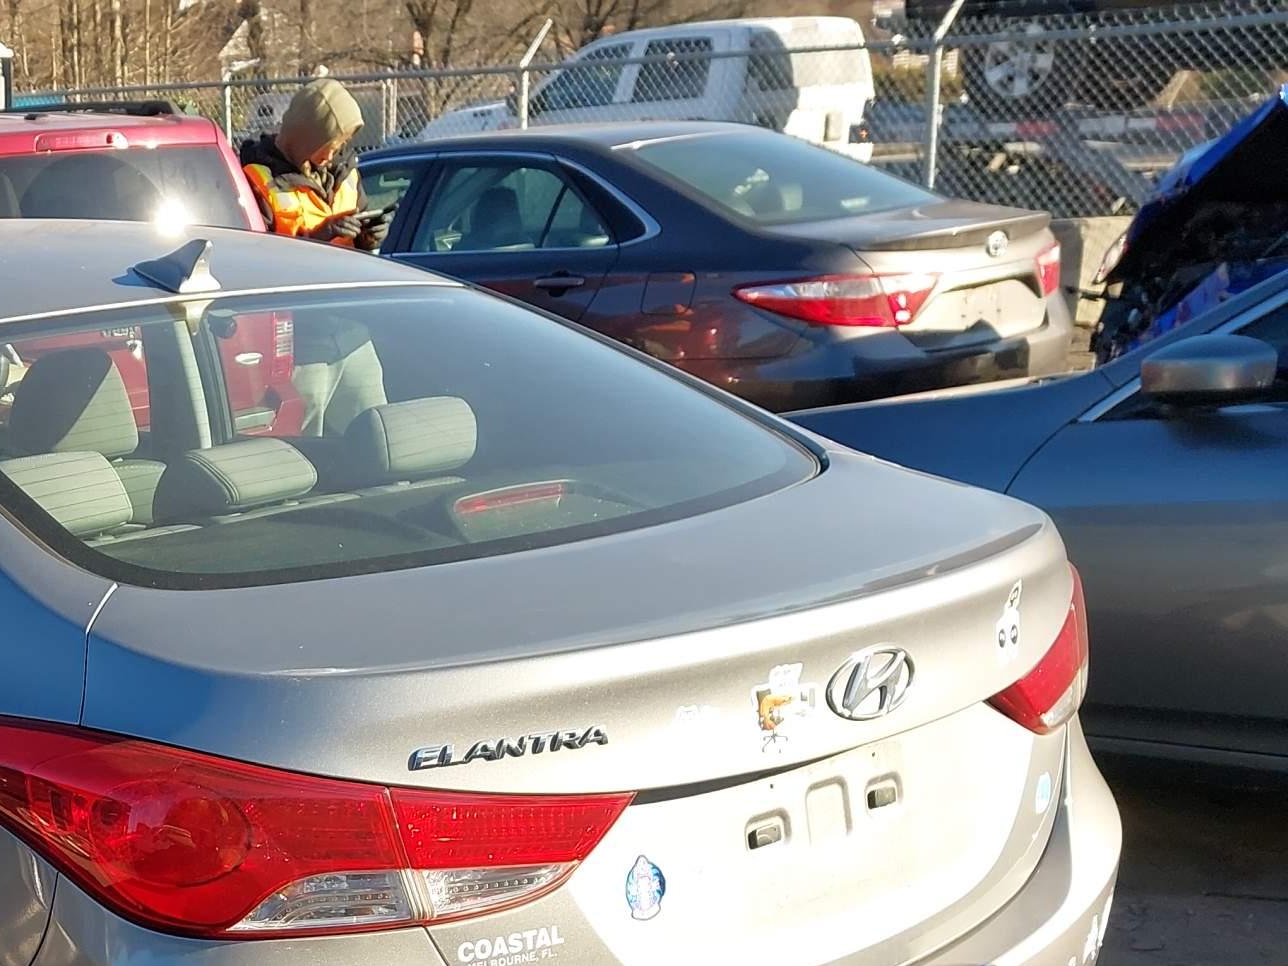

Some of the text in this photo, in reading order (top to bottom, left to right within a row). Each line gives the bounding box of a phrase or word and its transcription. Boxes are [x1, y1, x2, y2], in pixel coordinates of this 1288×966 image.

[407, 725, 610, 772] ELANTRA
[457, 925, 565, 963] COASTAL
[541, 947, 558, 959] FL.
